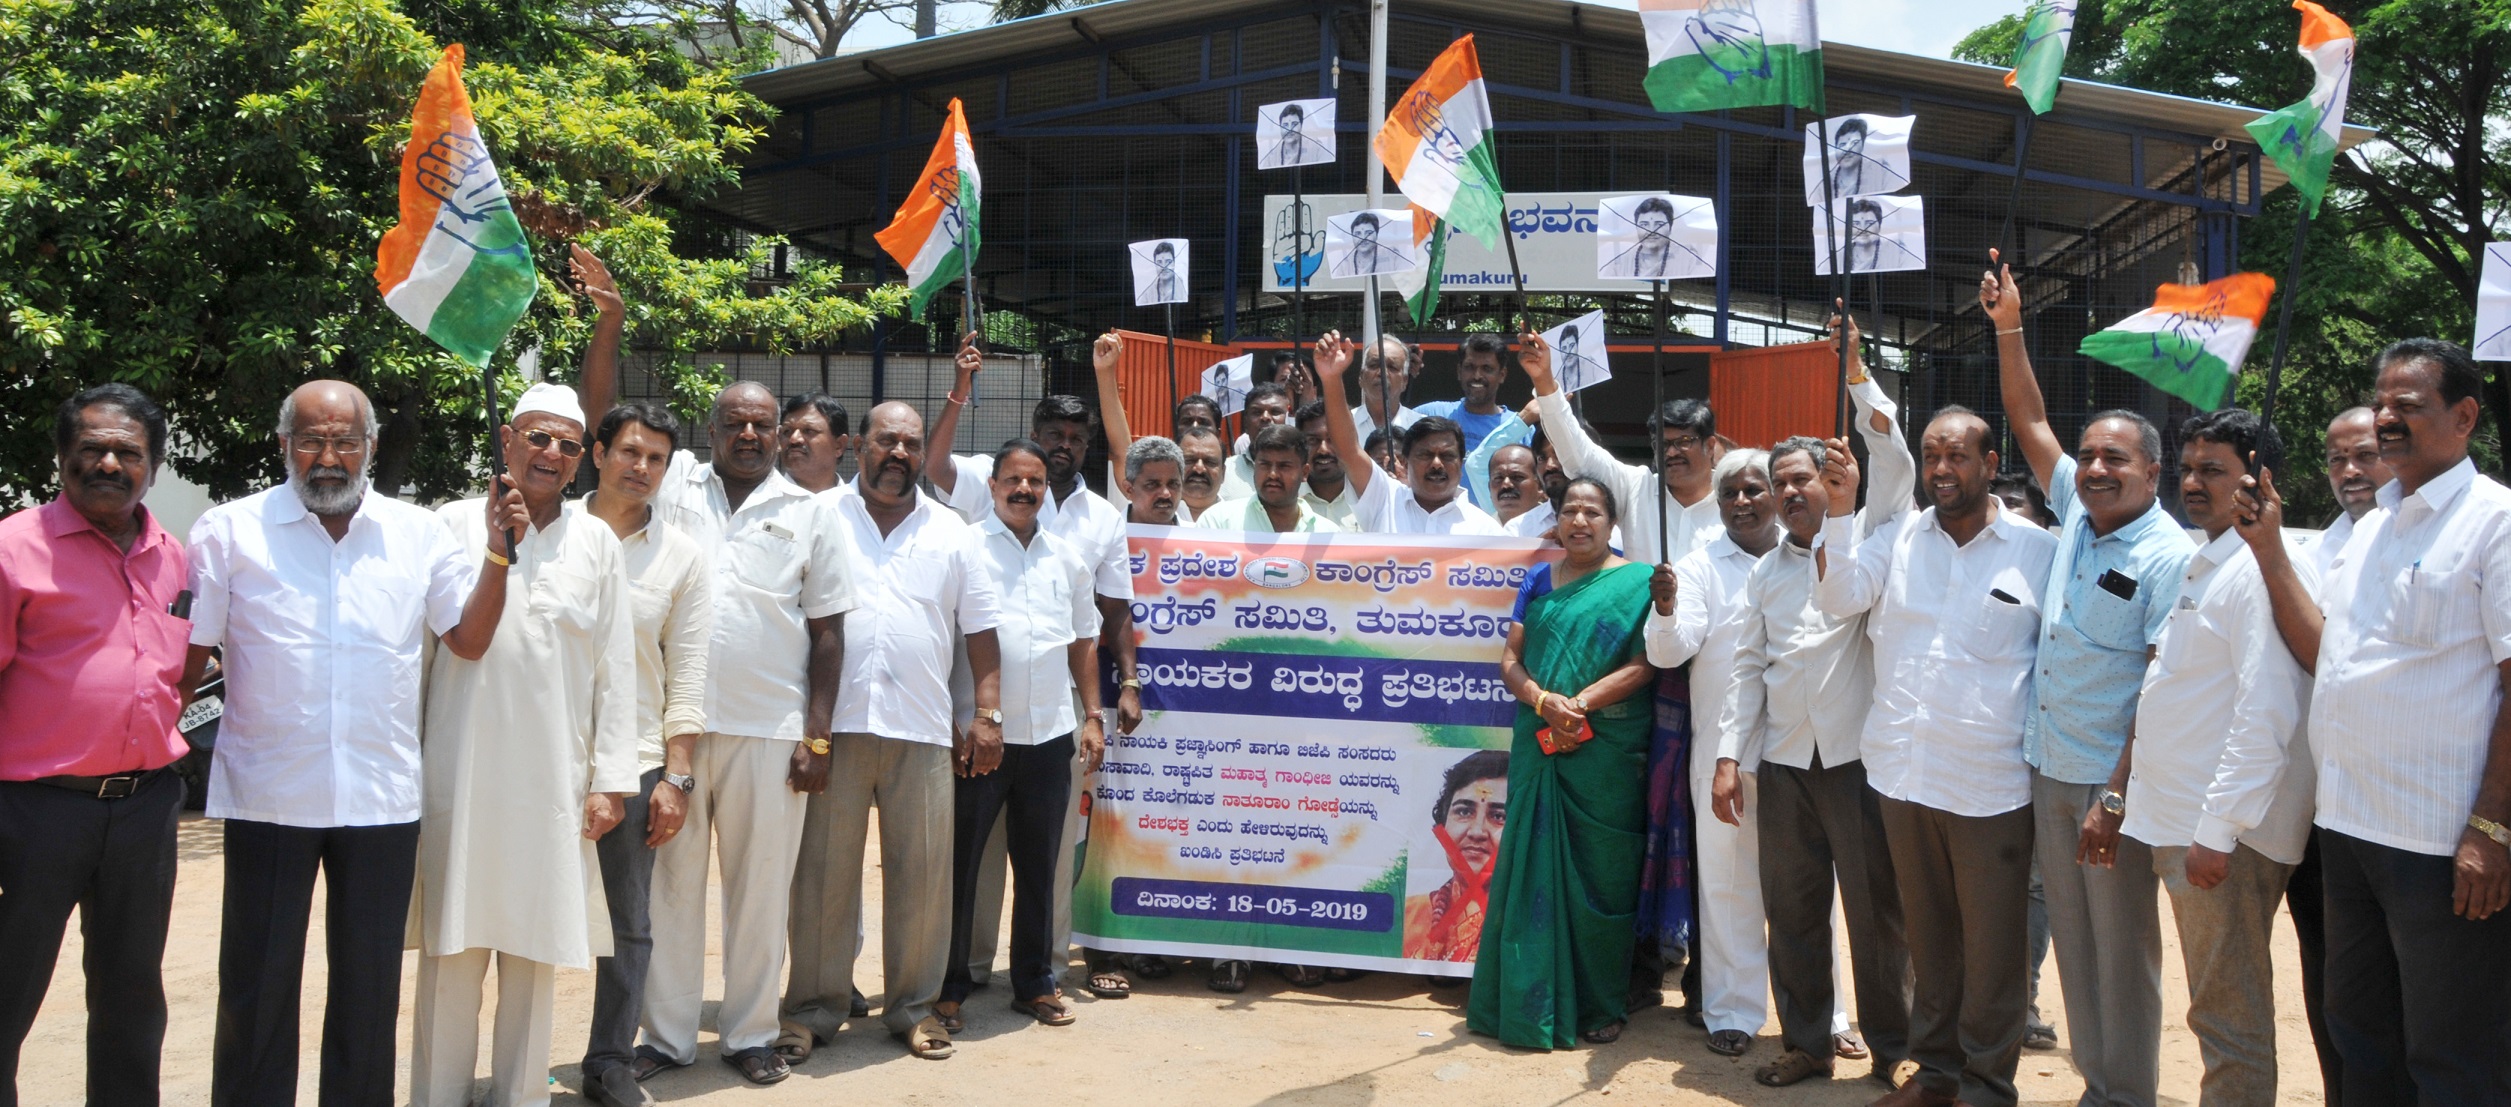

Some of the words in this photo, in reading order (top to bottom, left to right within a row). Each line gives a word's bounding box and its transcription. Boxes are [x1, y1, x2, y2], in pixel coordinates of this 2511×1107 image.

[1440, 270, 1528, 285] umakuru
[1160, 551, 1238, 584] ಪ್ರದೇಶ
[1315, 559, 1432, 593] ಕಾಂಗ್ರೆಸ್
[1448, 562, 1528, 588] ಸಮಿತಿ
[1130, 596, 1216, 635] ಂಗ್ರೆಸ್
[1235, 599, 1336, 635] ಸಮಿತಿ,
[1270, 664, 1364, 712] ವಿರುದ್ಧ
[183, 703, 211, 720] KA-04
[184, 708, 221, 729] JB-8742
[1119, 734, 1168, 749] ನಾಯಕಿ
[1249, 741, 1290, 756] ಹಾಗೂ
[1297, 743, 1331, 758] ಬಿಜೆಪಿ
[1338, 745, 1397, 761] ಸಂಸದರು
[1220, 766, 1268, 788] ಮಹಾತ್ಮ
[1275, 771, 1332, 786] ಗಾಂಧೀಜಿ
[1339, 772, 1400, 795] ಯವರನ್ನು
[1096, 784, 1135, 801] ಕೊಂದ
[1142, 787, 1215, 805] ಕೊಲೆಗಡುಕ
[1222, 793, 1291, 810] ನಾತೂರಾಂ
[1138, 814, 1190, 836] ದೇಶಭಕ್ತ
[1197, 818, 1233, 834] ಎಂದು
[1240, 819, 1329, 846] ಹೇಳಿರುವುದನ್ನು
[1180, 845, 1223, 860] ಖಂಡಿಸಿ
[1229, 846, 1285, 865] ಪ್ರತಿಭಟನೆ
[1136, 891, 1217, 911] ದಿನಾಂಕ:
[1227, 894, 1368, 921] 18-05-2019
